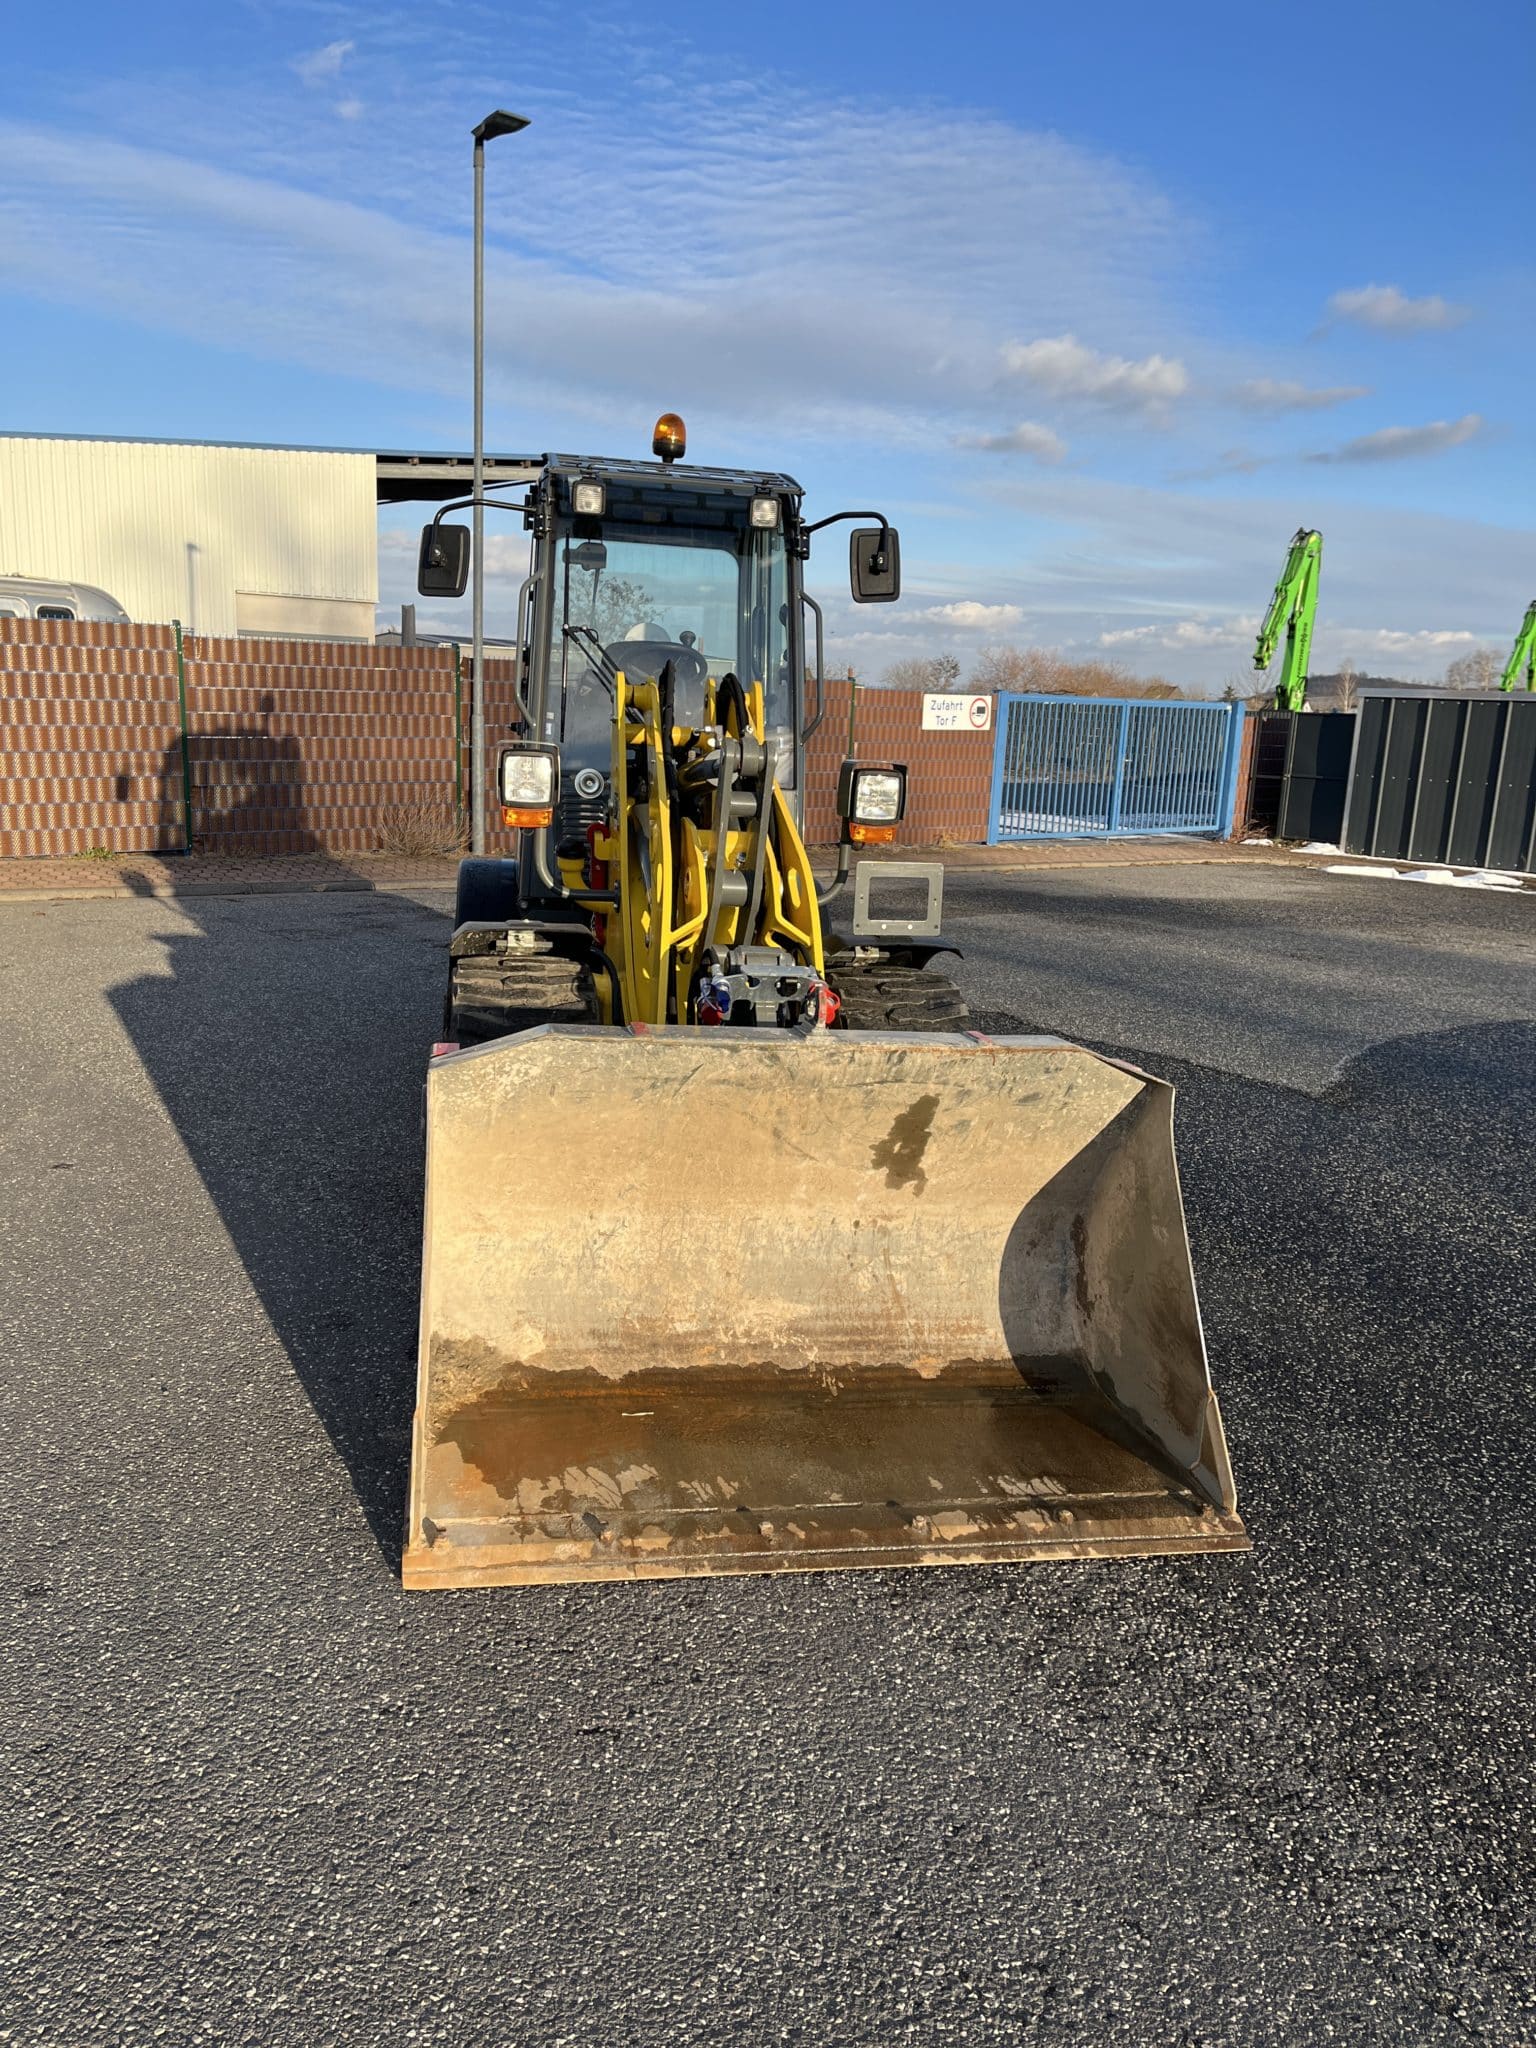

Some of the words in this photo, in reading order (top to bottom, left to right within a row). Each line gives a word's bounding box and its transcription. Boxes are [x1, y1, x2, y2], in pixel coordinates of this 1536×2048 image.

[931, 700, 963, 711] Zufahrt
[936, 716, 949, 726] Tor
[951, 716, 957, 726] F
